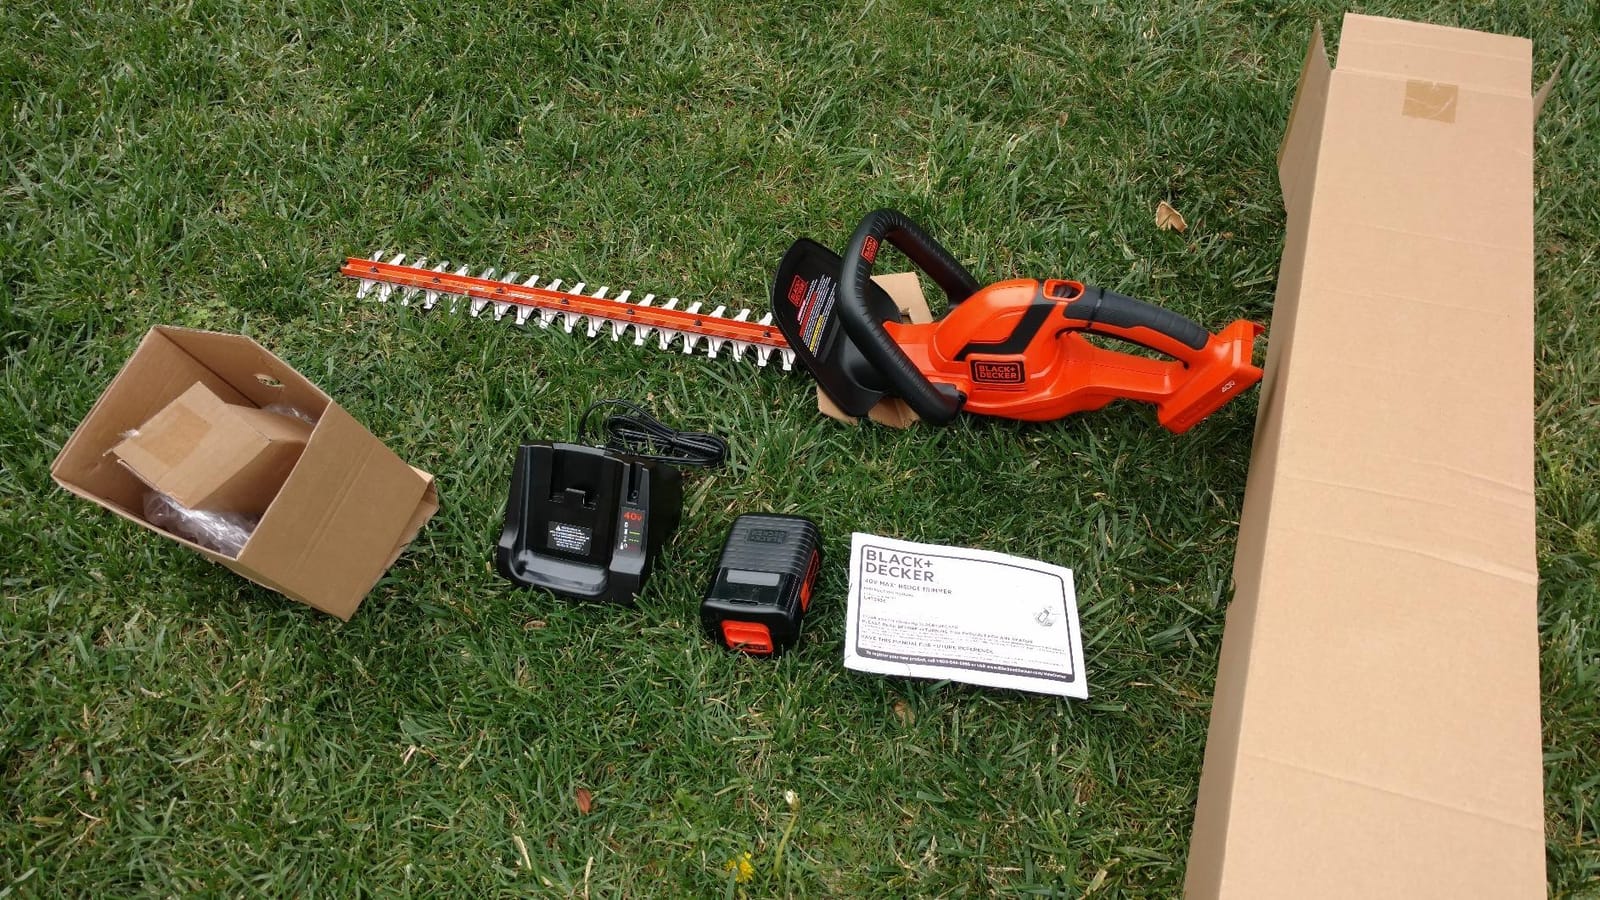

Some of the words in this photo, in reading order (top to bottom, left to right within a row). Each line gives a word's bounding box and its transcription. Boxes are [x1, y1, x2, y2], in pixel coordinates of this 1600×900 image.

[979, 365, 1016, 373] BLACK+
[866, 549, 933, 569] BLACK+
[866, 562, 934, 582] DECKER
[898, 584, 920, 592] HEDGE
